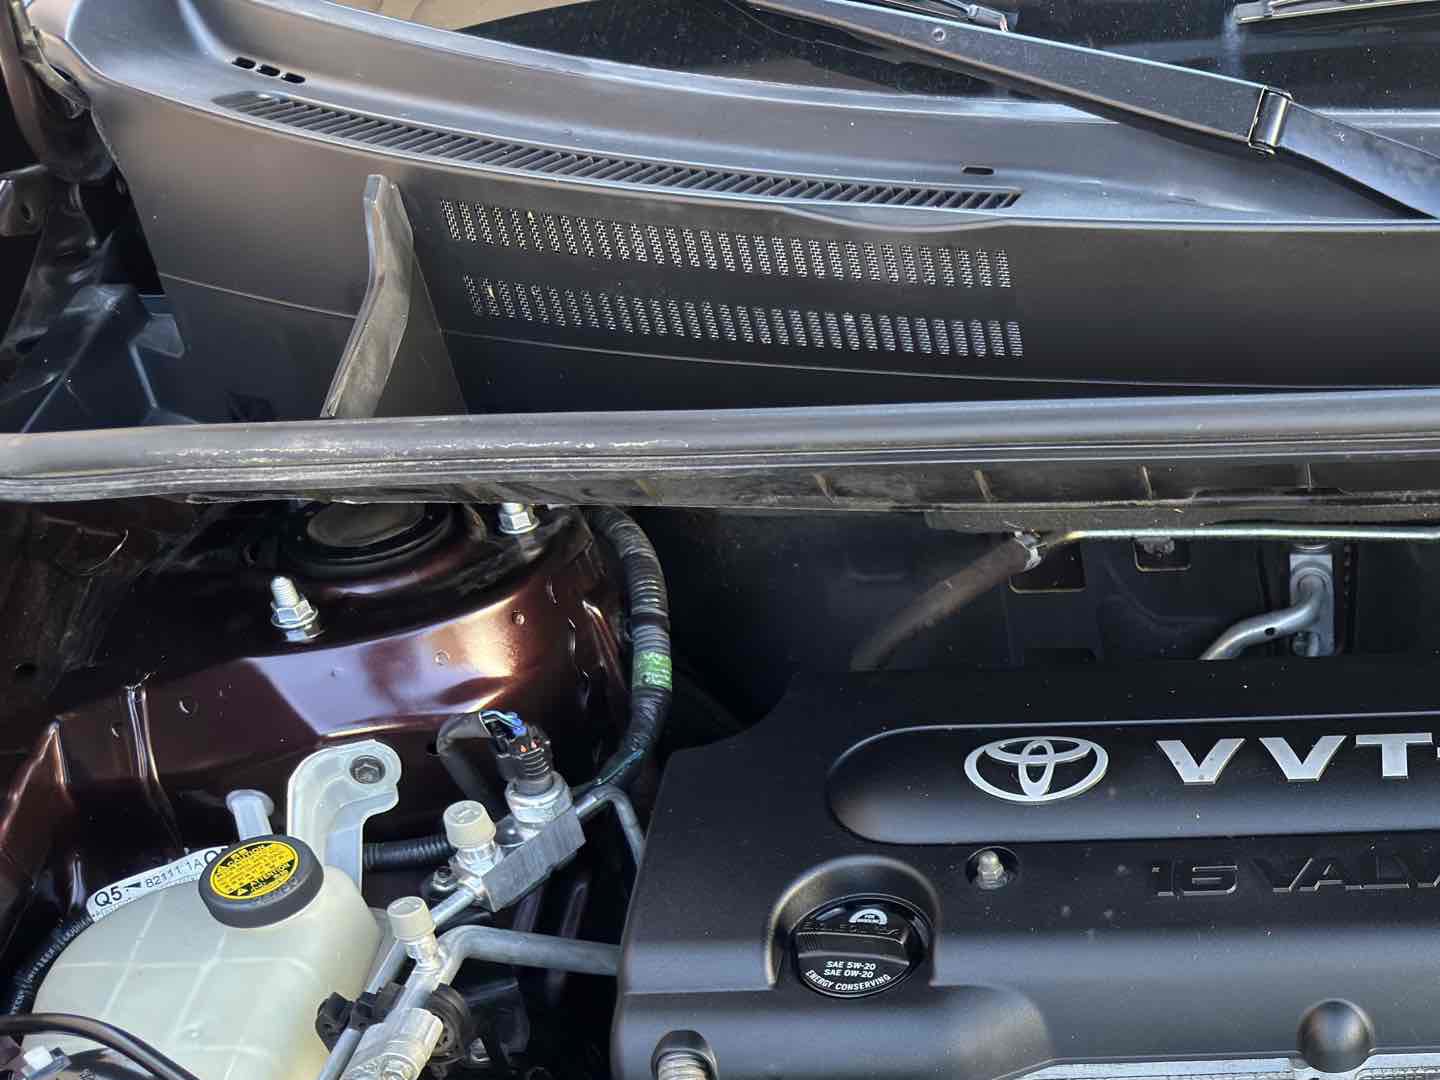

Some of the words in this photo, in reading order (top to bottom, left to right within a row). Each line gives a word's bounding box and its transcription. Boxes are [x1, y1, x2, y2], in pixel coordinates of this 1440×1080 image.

[1152, 859, 1239, 897] 16
[95, 886, 122, 907] Q5
[824, 969, 842, 977] SAE
[843, 970, 873, 978] 0W-20
[826, 961, 845, 969] SAE
[846, 961, 877, 971] 5W-20
[805, 970, 834, 988] ENERGY
[835, 974, 891, 991] CONSERVING
